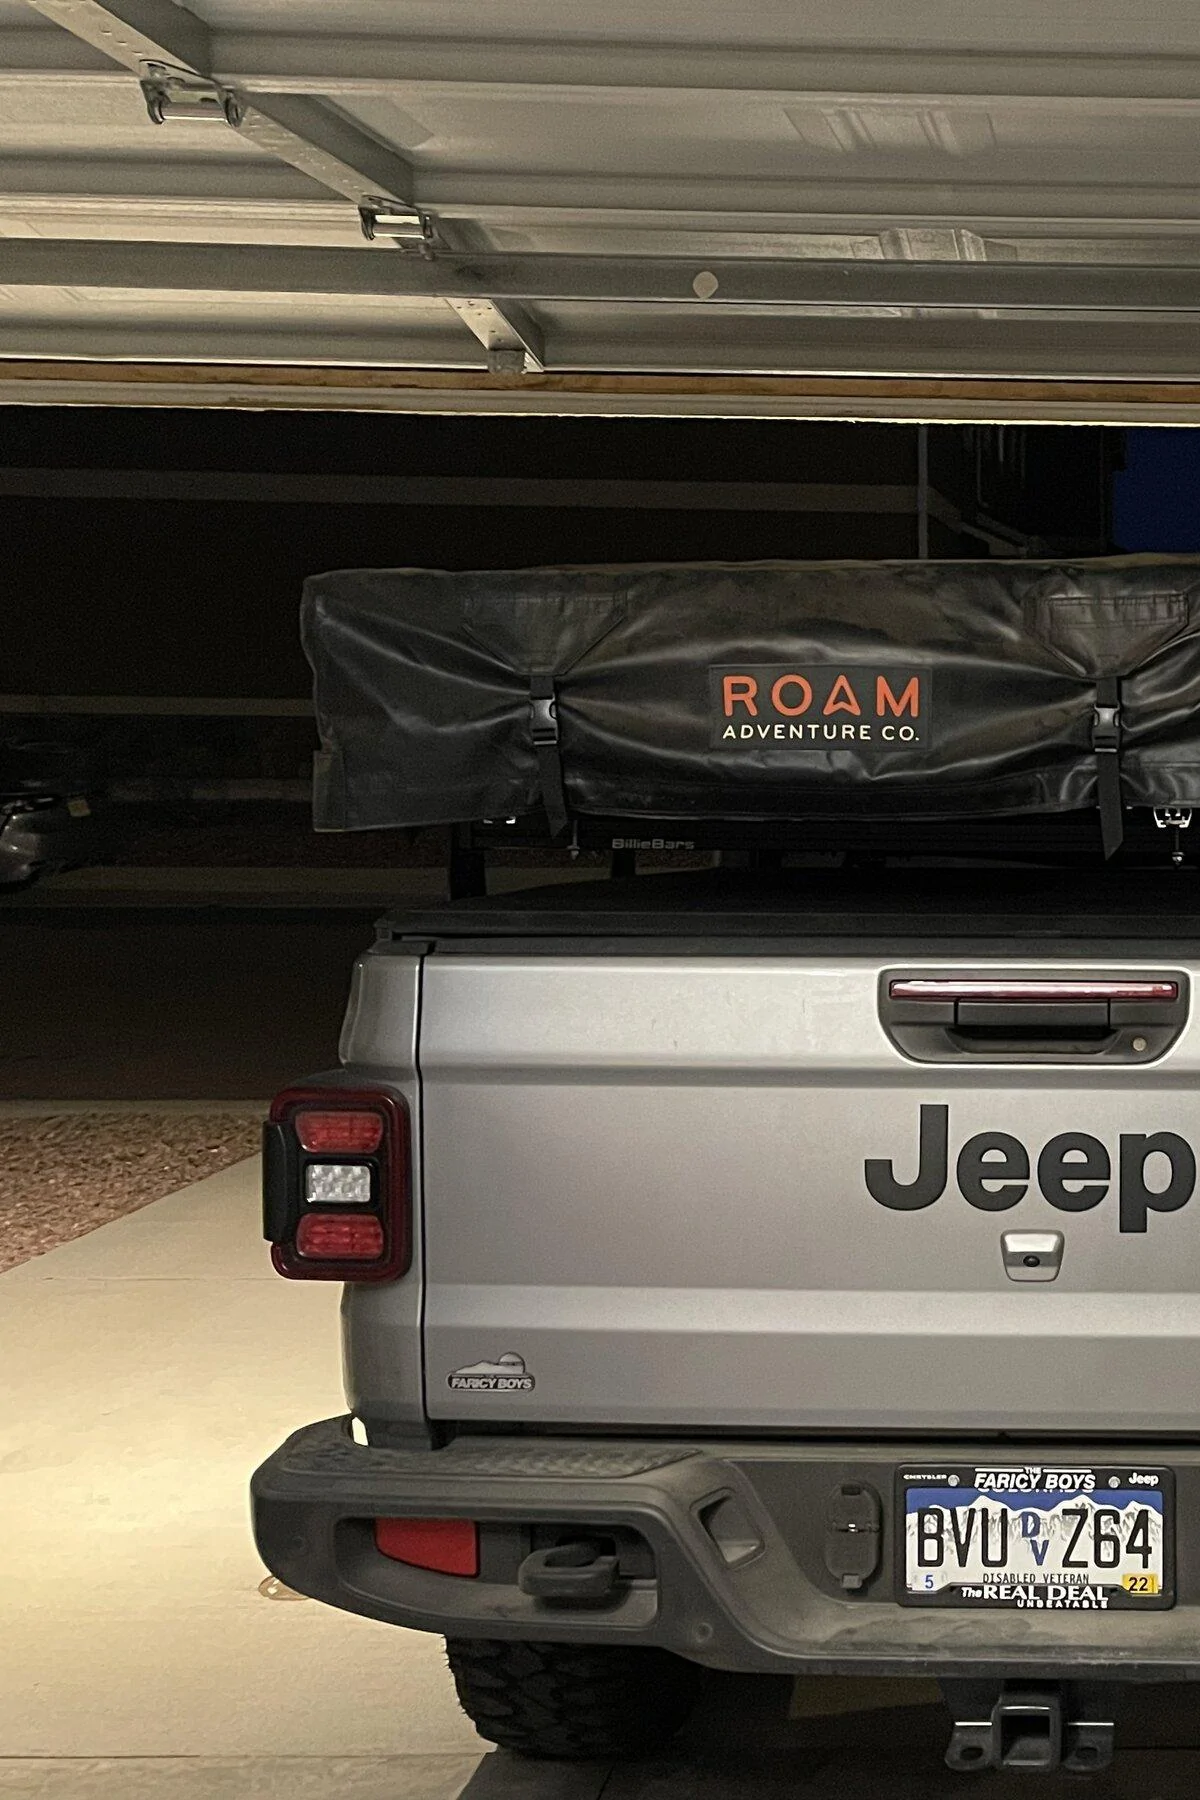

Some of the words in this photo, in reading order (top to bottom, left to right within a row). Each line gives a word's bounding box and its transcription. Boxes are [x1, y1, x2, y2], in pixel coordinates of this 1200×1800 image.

[723, 674, 919, 718] ROAM
[722, 724, 872, 740] ADVENTURE
[881, 725, 920, 741] CO.
[612, 838, 695, 849] BillieBars
[864, 1104, 1197, 1233] Jeep
[451, 1378, 497, 1389] FARICY
[497, 1378, 532, 1389] BOYS
[974, 1473, 1041, 1489] FARICY
[1045, 1474, 1096, 1489] BOYS
[1128, 1472, 1159, 1486] Jeep
[917, 1508, 1008, 1567] BVU
[1062, 1508, 1152, 1568] Z64
[924, 1574, 934, 1589] 5
[982, 1573, 1036, 1584] DISABLED
[1043, 1573, 1089, 1584] VETERAN
[1128, 1576, 1149, 1592] 22
[961, 1586, 983, 1598] The
[983, 1585, 1040, 1600] REAL
[1047, 1585, 1109, 1601] DEAL
[1017, 1600, 1108, 1609] UNBEATABLE
